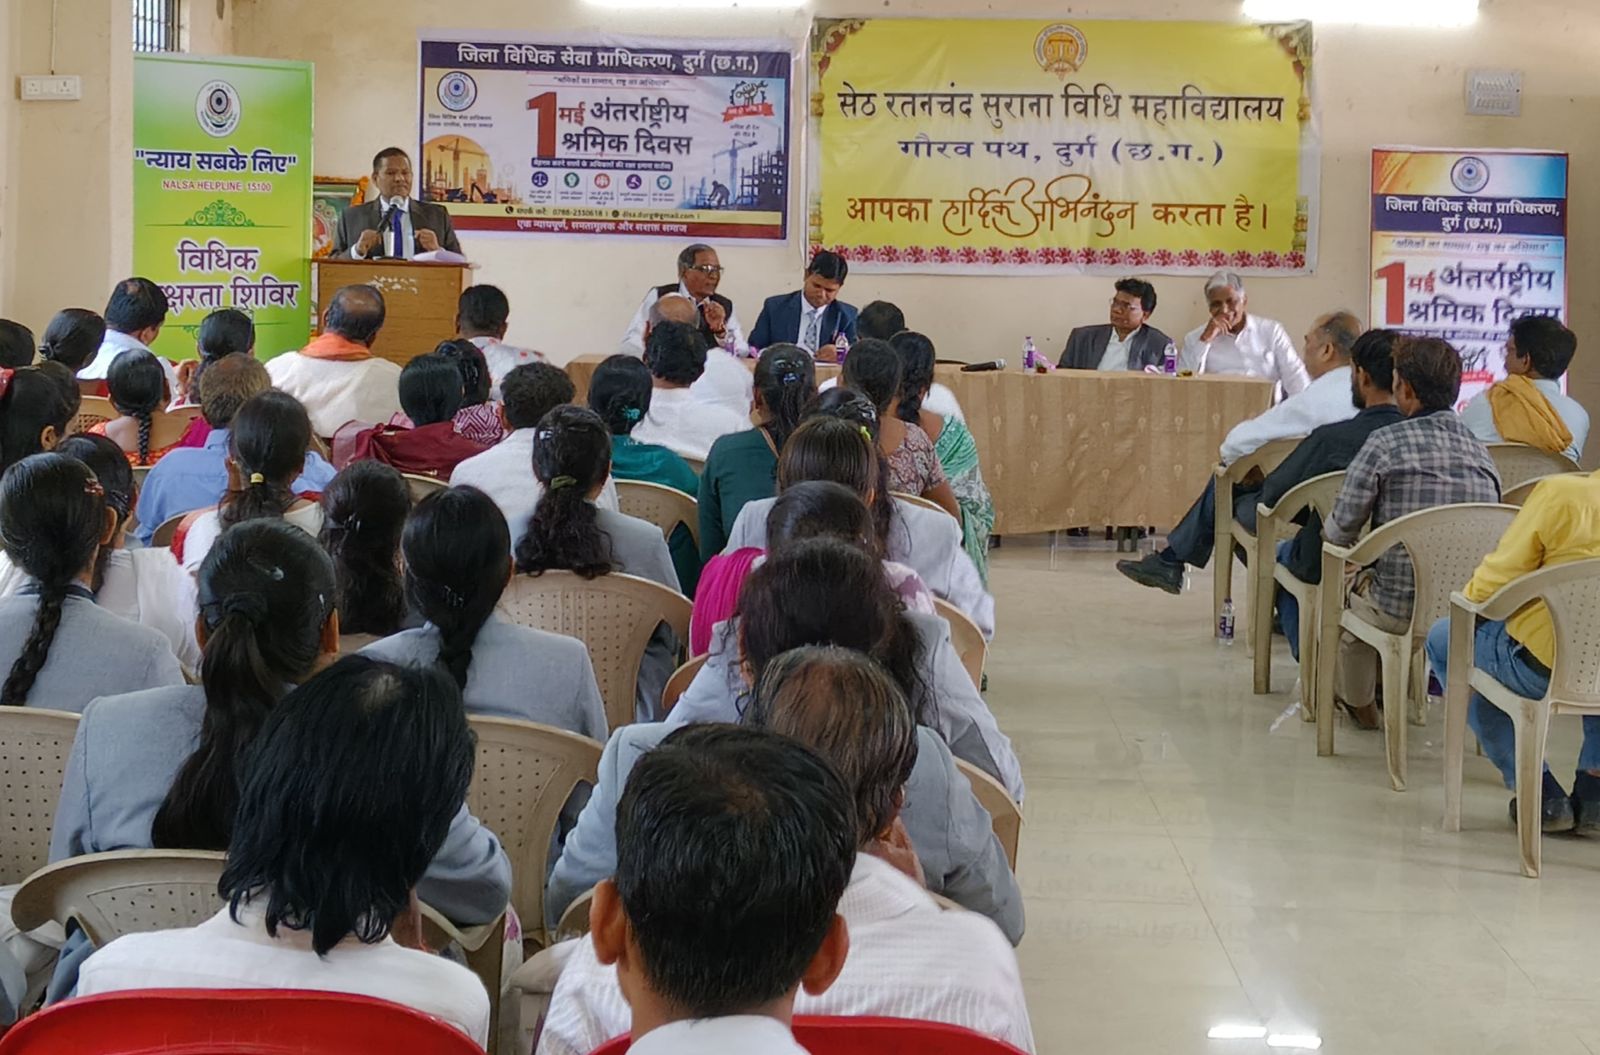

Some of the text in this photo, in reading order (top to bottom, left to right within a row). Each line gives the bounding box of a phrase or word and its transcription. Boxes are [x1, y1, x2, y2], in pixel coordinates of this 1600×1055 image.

[458, 43, 759, 75] जिला विधिक सेवा प्राधिकरण, दुर्ग (छ.ग.)
[837, 81, 1284, 129] सेठ रतनचंद सुराना विधि महाविद्यालय
[526, 92, 689, 159] 1 मई अंतर्राष्ट्रीय
[562, 126, 693, 155] श्रमिक दिवस
[196, 148, 248, 171] सबके
[898, 132, 974, 158] गौरव
[1052, 134, 1097, 167] दुर्ग
[162, 180, 272, 192] NALSA HELPLINE 15100
[846, 198, 933, 222] आपका
[1152, 203, 1226, 226] करता
[1385, 196, 1560, 217] जिला विधिक सेवा प्राधिकरण,
[1441, 214, 1502, 233] दुर्ग (छ.ग.)
[176, 240, 258, 271] विधिक
[230, 276, 299, 310] शिविर
[1375, 261, 1405, 326] 1
[1408, 269, 1437, 294] मई
[1408, 295, 1487, 324] श्रमिक
